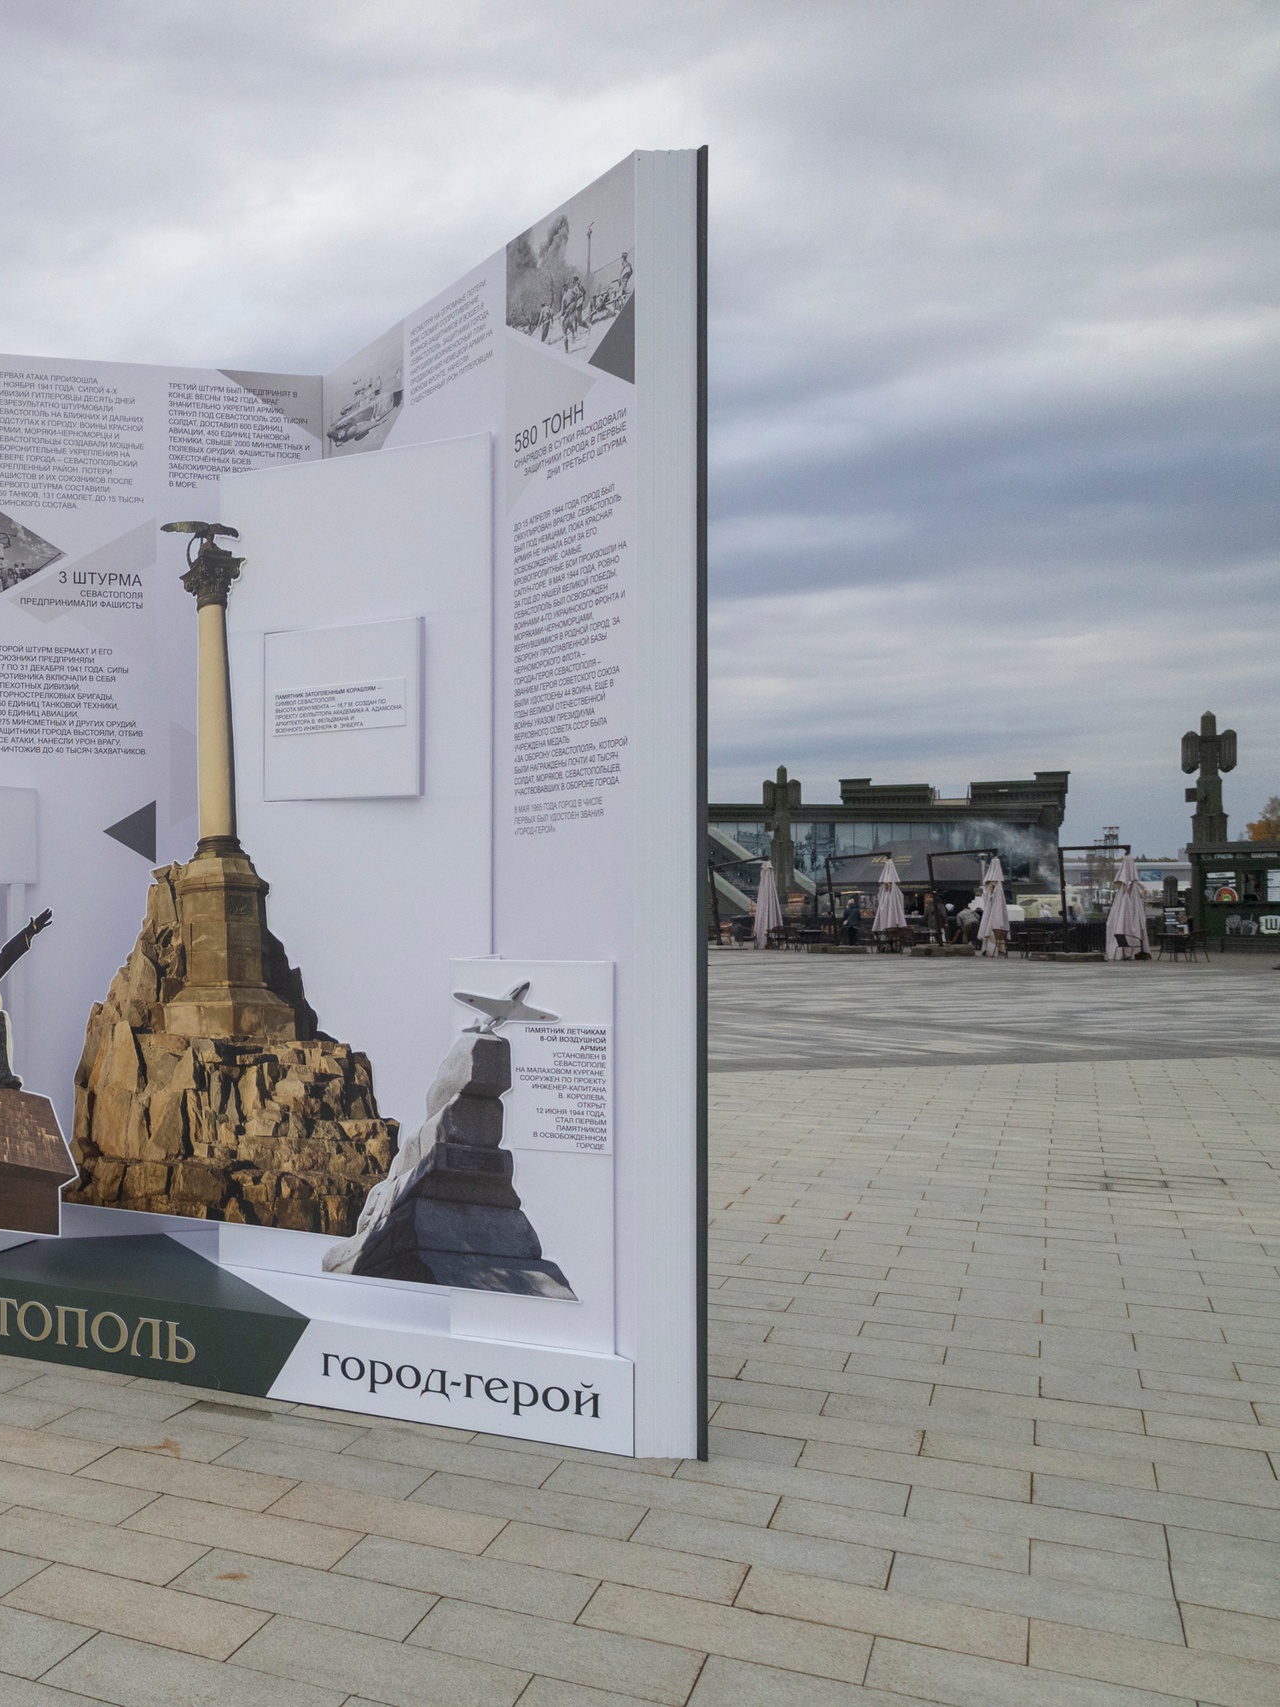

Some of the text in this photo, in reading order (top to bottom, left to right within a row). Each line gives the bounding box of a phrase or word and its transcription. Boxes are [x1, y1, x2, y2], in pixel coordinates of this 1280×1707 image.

[543, 401, 584, 439] ТОНН
[514, 408, 626, 470] СНАРЯДОВ В СУТКИ РАСХОДОВАЛИ
[524, 421, 626, 477] ЗАЩИТНИКИ ГОРОДА В ПЕРВЫЕ
[547, 435, 627, 480] ДНИ ТРЕТЬЕГО ШТУРМА
[59, 571, 142, 587] 3 ШТУРМА
[80, 590, 143, 600] СЕВАСТОПОЛЯ
[20, 598, 143, 609] ПРЕДПРИНИМАЛИ ФАШИСТЫ
[39, 656, 94, 664] ПРЕДПРИНЯЛИ
[46, 674, 87, 682] ВКЛЮЧАЛИ
[559, 1036, 606, 1044] ВОЗДУШНОЙ
[552, 1052, 600, 1060] УСТАНОВЛЕН
[554, 1060, 606, 1068] СЕВАСТОПОЛЕ
[527, 1067, 572, 1075] МАЛАХОВОМ
[322, 1353, 601, 1419] город-герой
